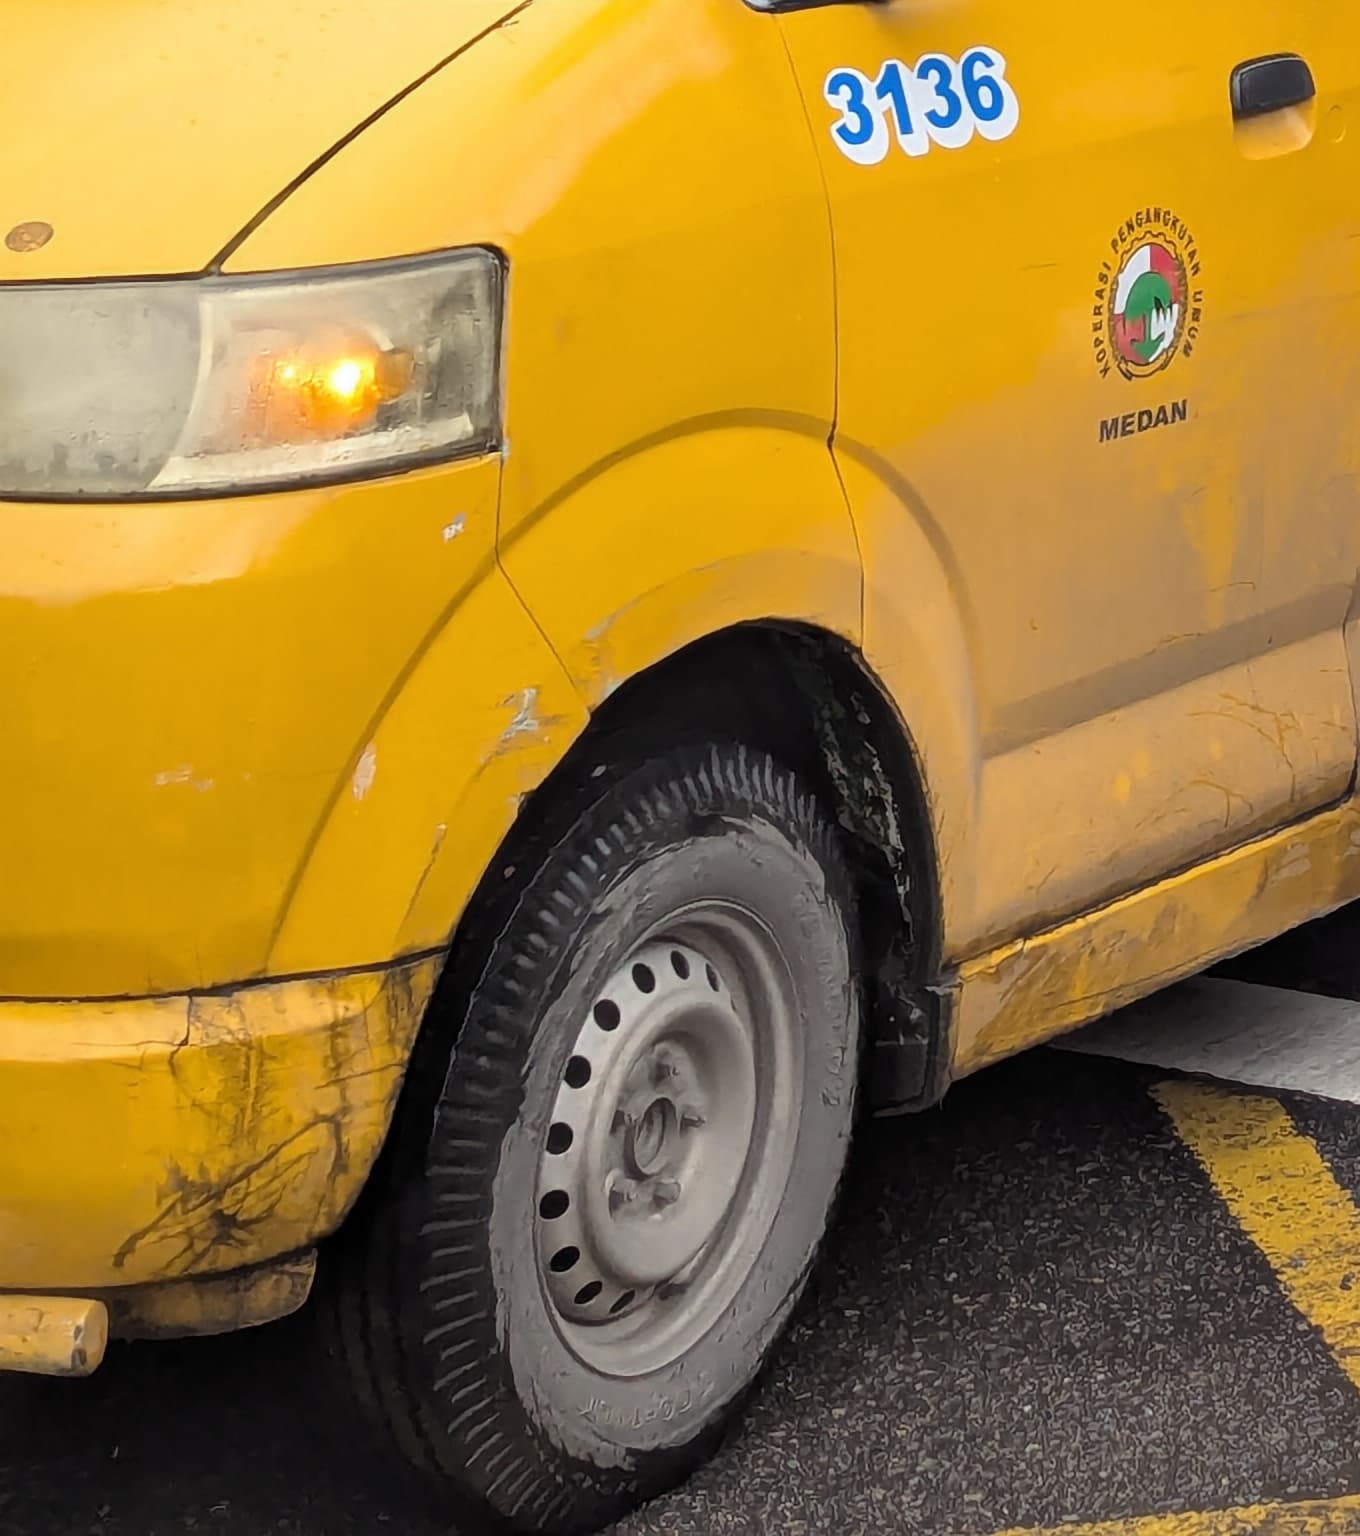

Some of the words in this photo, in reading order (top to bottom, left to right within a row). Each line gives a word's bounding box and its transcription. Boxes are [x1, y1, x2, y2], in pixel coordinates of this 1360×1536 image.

[828, 50, 1005, 146] 3136
[1091, 261, 1113, 378] KOPERASI
[1099, 399, 1188, 443] MEDAN
